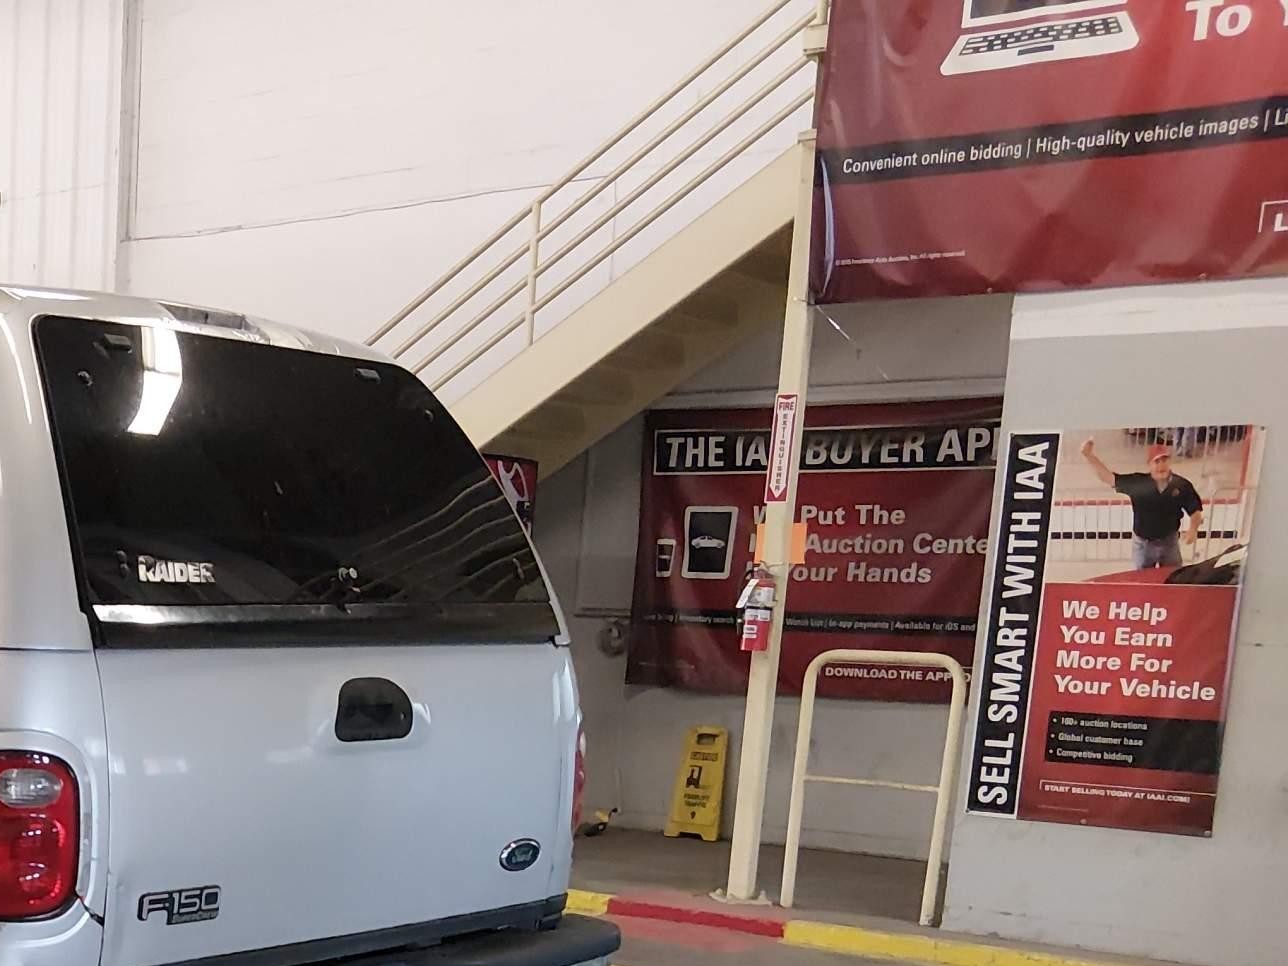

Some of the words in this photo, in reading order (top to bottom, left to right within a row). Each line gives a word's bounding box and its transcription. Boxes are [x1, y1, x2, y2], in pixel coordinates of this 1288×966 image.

[1185, 0, 1252, 41] To
[842, 152, 918, 174] Convenient
[921, 149, 964, 166] online
[970, 142, 1022, 161] bidding
[1036, 129, 1131, 155] High-quality
[1134, 122, 1194, 143] vehicle
[1198, 115, 1260, 136] images
[779, 402, 794, 411] FIRE
[665, 436, 725, 467] THE
[735, 435, 769, 467] IA
[804, 433, 926, 465] BUYER
[935, 427, 999, 463] AP
[1013, 441, 1050, 500] IAA
[800, 505, 846, 525] Put
[855, 504, 906, 525] The
[805, 533, 904, 554] Auction
[913, 533, 988, 555] Cente
[1001, 512, 1042, 599] WITH
[138, 555, 216, 583] RAIDER
[847, 562, 932, 583] Hands
[1062, 600, 1100, 619] We
[1108, 601, 1168, 626] Help
[960, 623, 976, 632] and
[1060, 625, 1106, 645] You
[1114, 627, 1173, 647] Earn
[987, 607, 1029, 724] SMART
[1056, 650, 1121, 670] More
[1130, 653, 1173, 673] For
[825, 667, 898, 680] DOWNLOAD
[901, 670, 923, 681] THE
[925, 671, 953, 682] APP
[1054, 674, 1111, 695] Your
[1120, 677, 1216, 701] Vehicle
[1079, 719, 1109, 729] auction
[1111, 720, 1148, 730] locations
[1058, 732, 1083, 742] Global
[1085, 735, 1122, 745] customer
[1123, 737, 1144, 746] base
[1056, 748, 1101, 760] Competitive
[1103, 752, 1133, 763] bidding
[977, 732, 1015, 805] SELL
[1044, 784, 1070, 794] START
[1105, 789, 1133, 798] TODAY
[1134, 792, 1145, 800] AT
